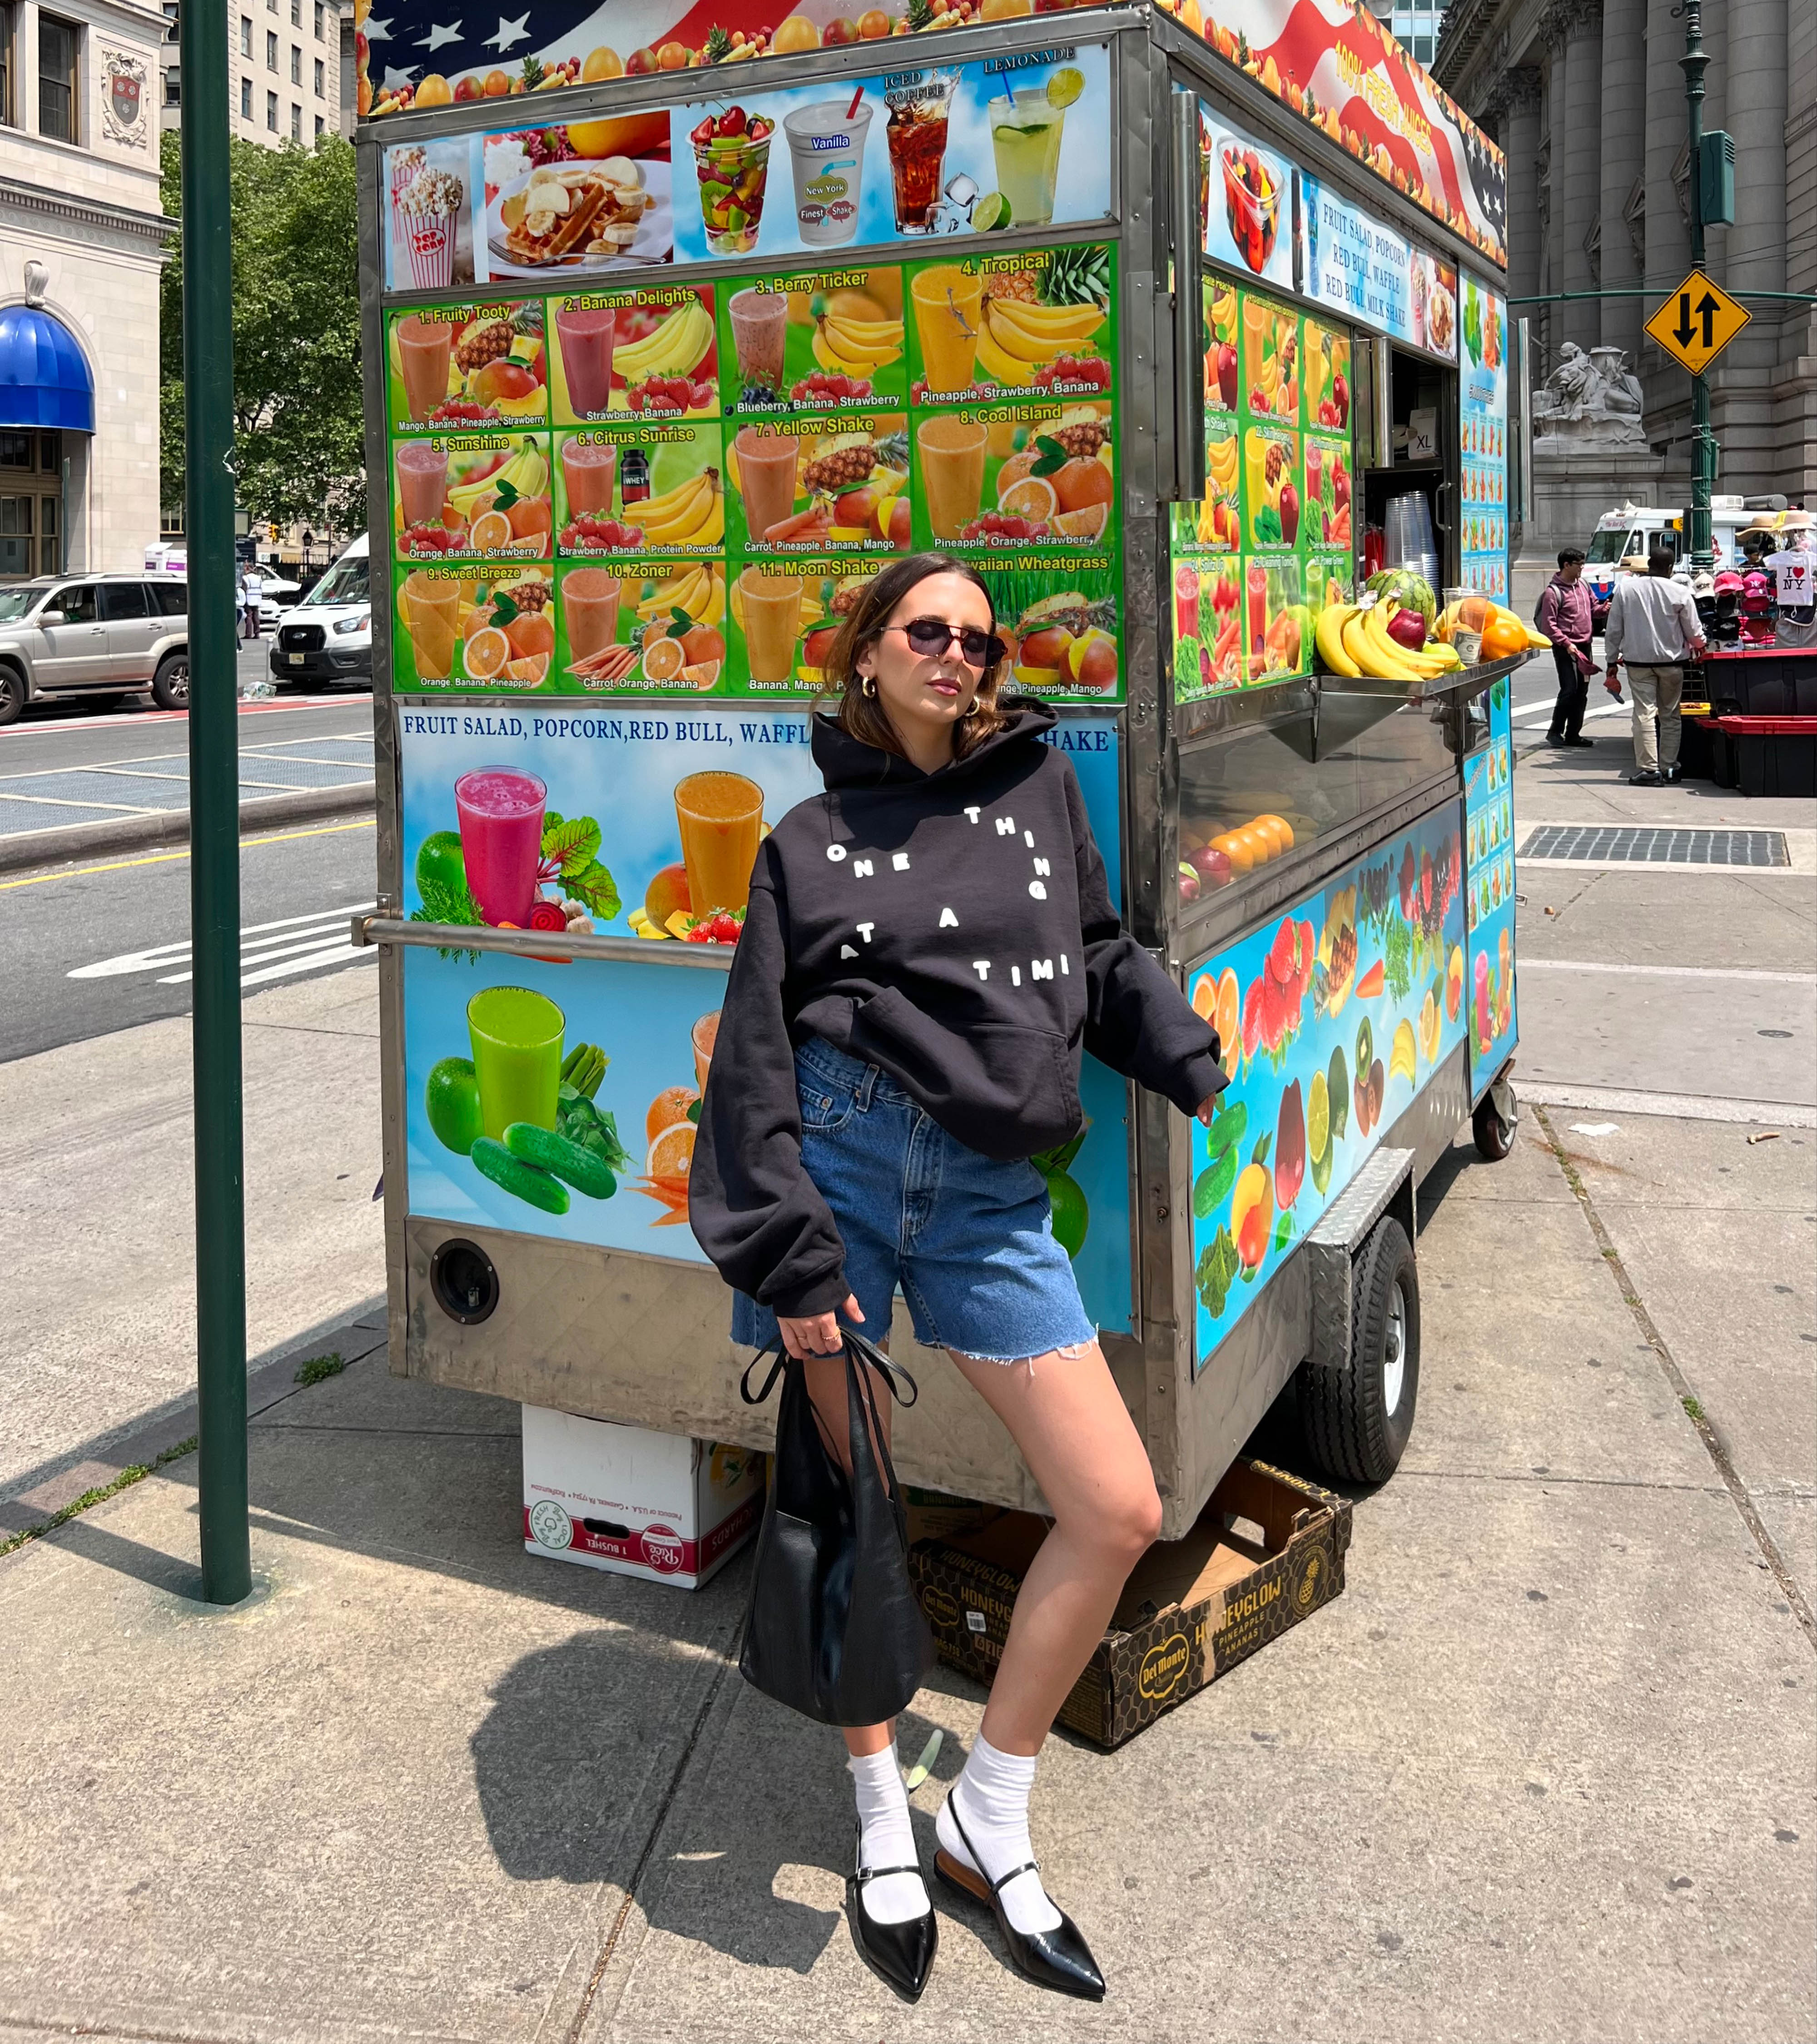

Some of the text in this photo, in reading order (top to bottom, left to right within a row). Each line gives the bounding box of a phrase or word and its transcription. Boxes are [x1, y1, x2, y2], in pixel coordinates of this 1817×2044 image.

[984, 47, 1075, 74] LEMONADE
[884, 72, 921, 89] ICED
[885, 84, 944, 105] COFFEE
[1335, 40, 1431, 156] 100% FRESH JUICES
[812, 135, 849, 150] Vanilla
[806, 182, 844, 195] New York
[800, 205, 853, 219] Finest Shake
[413, 232, 436, 244] POP
[416, 237, 444, 252] CORN
[1324, 203, 1405, 268] FRUIT SALAD, POPCORN
[961, 253, 1049, 276] 4. Tropical
[1333, 244, 1400, 294] RED BULL, WAFFLE
[755, 273, 868, 294] 3. Berry Ticker
[565, 288, 695, 312] 2. Banana Delights
[1326, 274, 1405, 327] RED BULL, MILK SHAKE
[418, 305, 510, 324] 1. Fruity Tooty
[921, 382, 1098, 402] Pineapple, Strawberry, Banana
[737, 395, 899, 413] Blueberry, Banana, Strawberry
[399, 415, 545, 432] Mango, Banana, Pineapple, Strawberry
[586, 408, 682, 421] Strawberry, Banana
[960, 405, 1062, 424] 8. Cool Island
[755, 417, 874, 437] 7. Yellow Shake
[432, 436, 509, 451] 5. Sunshine
[577, 428, 695, 446] 6. Citrus Sunrise
[1416, 435, 1432, 449] XL
[559, 544, 721, 556] Strawberry, Banana, Protein Powder
[745, 539, 894, 553] Carrot, Pineapple, Banana, Mango
[934, 538, 987, 549] Pineapple,
[991, 536, 1033, 547] Orange,
[409, 547, 538, 559] Orange, Banana, Strawberry
[427, 566, 521, 580] 9. Sweet Breeze
[606, 565, 673, 578] 10. Zoner
[760, 560, 879, 576] 11. Moon Shake
[967, 556, 1108, 572] waiian Wheatgrass
[1786, 568, 1792, 578] I
[1783, 580, 1805, 590] NY
[421, 678, 531, 689] Orange, Banana, Pineapple
[583, 678, 699, 690] Carrot, Orange, Banana
[749, 680, 791, 691] Banana,
[794, 680, 833, 692] Mang,
[995, 684, 1102, 695] ange, Pineapple, Mango
[404, 716, 457, 734] FRUIT
[464, 717, 527, 741] SALAD,
[675, 722, 733, 747] BULL,
[740, 724, 810, 744] WAFFL
[827, 807, 1050, 899] ONE THING
[939, 908, 958, 928] A
[534, 1506, 549, 1525] FRESH
[553, 1525, 567, 1544] LOCAL
[586, 1538, 620, 1553] BUSHEL
[649, 1545, 679, 1564] Rice
[961, 1586, 1012, 1622] HONEYG
[1196, 1576, 1281, 1646] HEYGLOW
[1219, 1612, 1264, 1647] PINEAPPLE
[1225, 1628, 1258, 1655] ANANAS
[1143, 1660, 1157, 1684] Del
[1158, 1647, 1186, 1672] Monte
